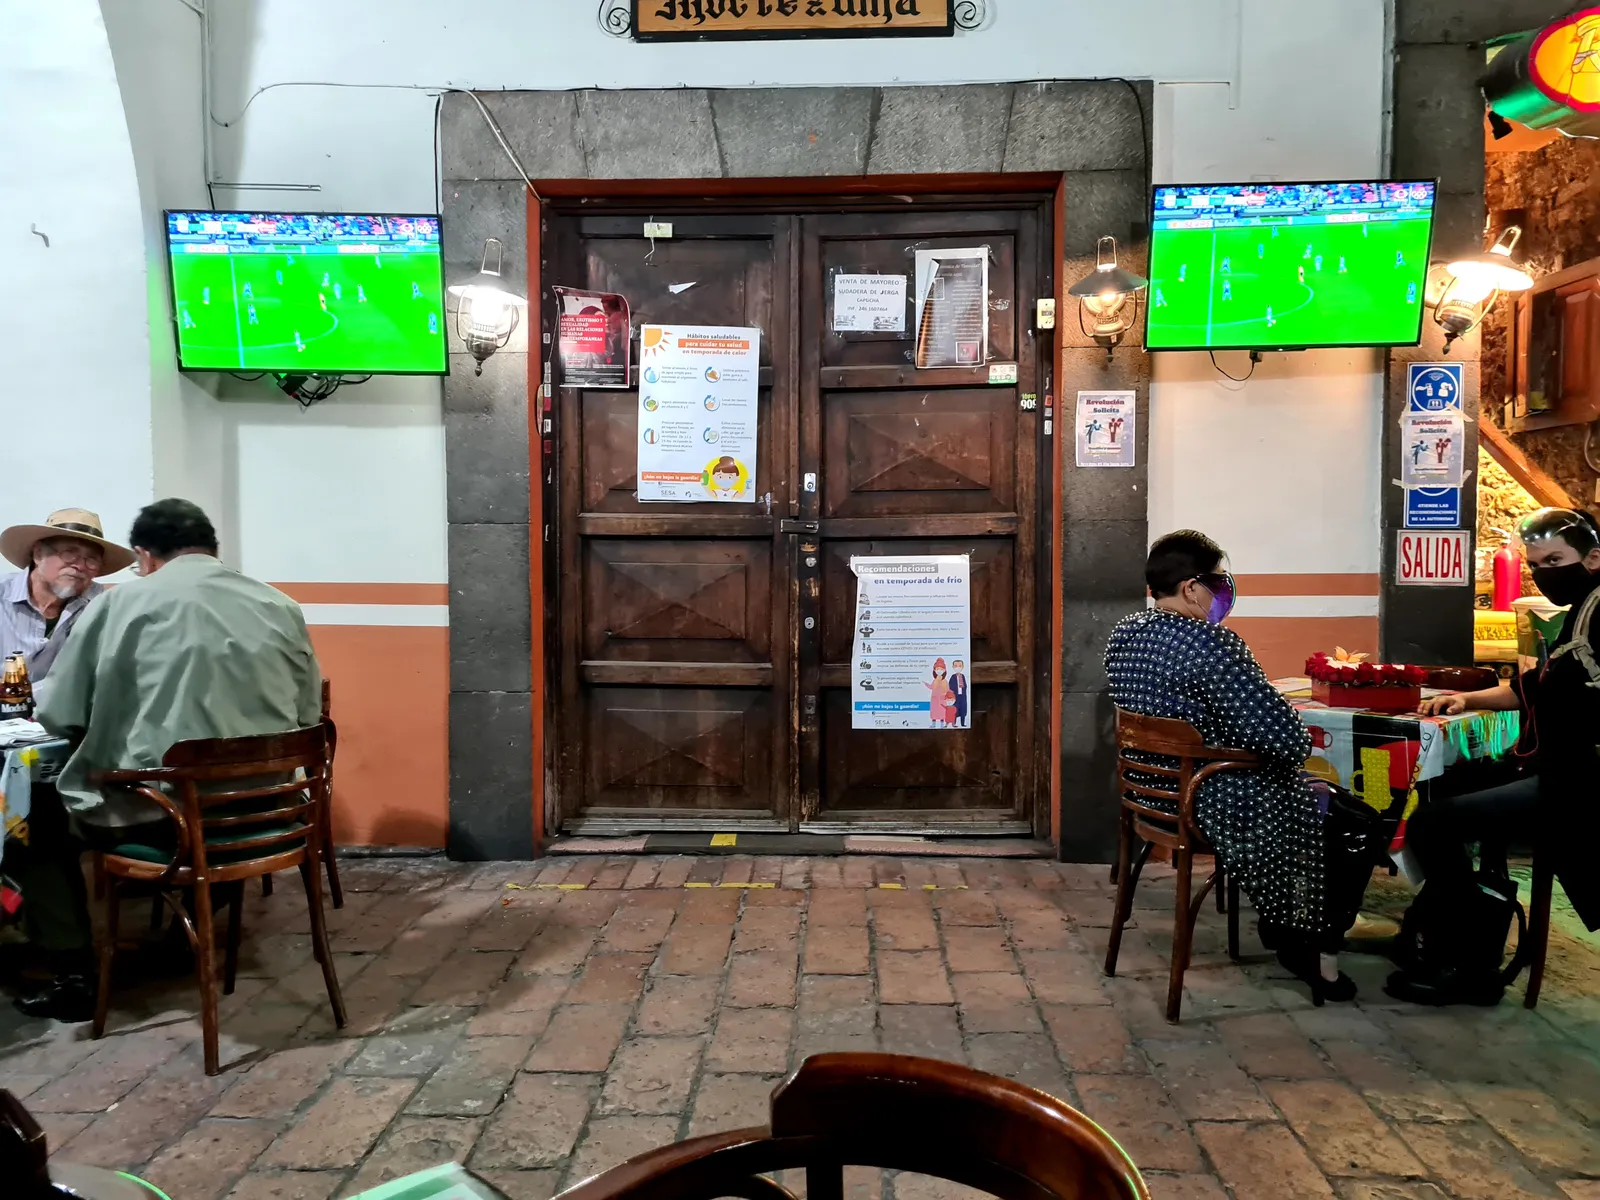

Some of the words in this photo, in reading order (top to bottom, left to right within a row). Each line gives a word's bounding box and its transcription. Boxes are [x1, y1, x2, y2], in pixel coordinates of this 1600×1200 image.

[1402, 536, 1463, 578] SALIDA
[858, 565, 936, 573] Recomendaciones
[887, 577, 932, 586] temporada
